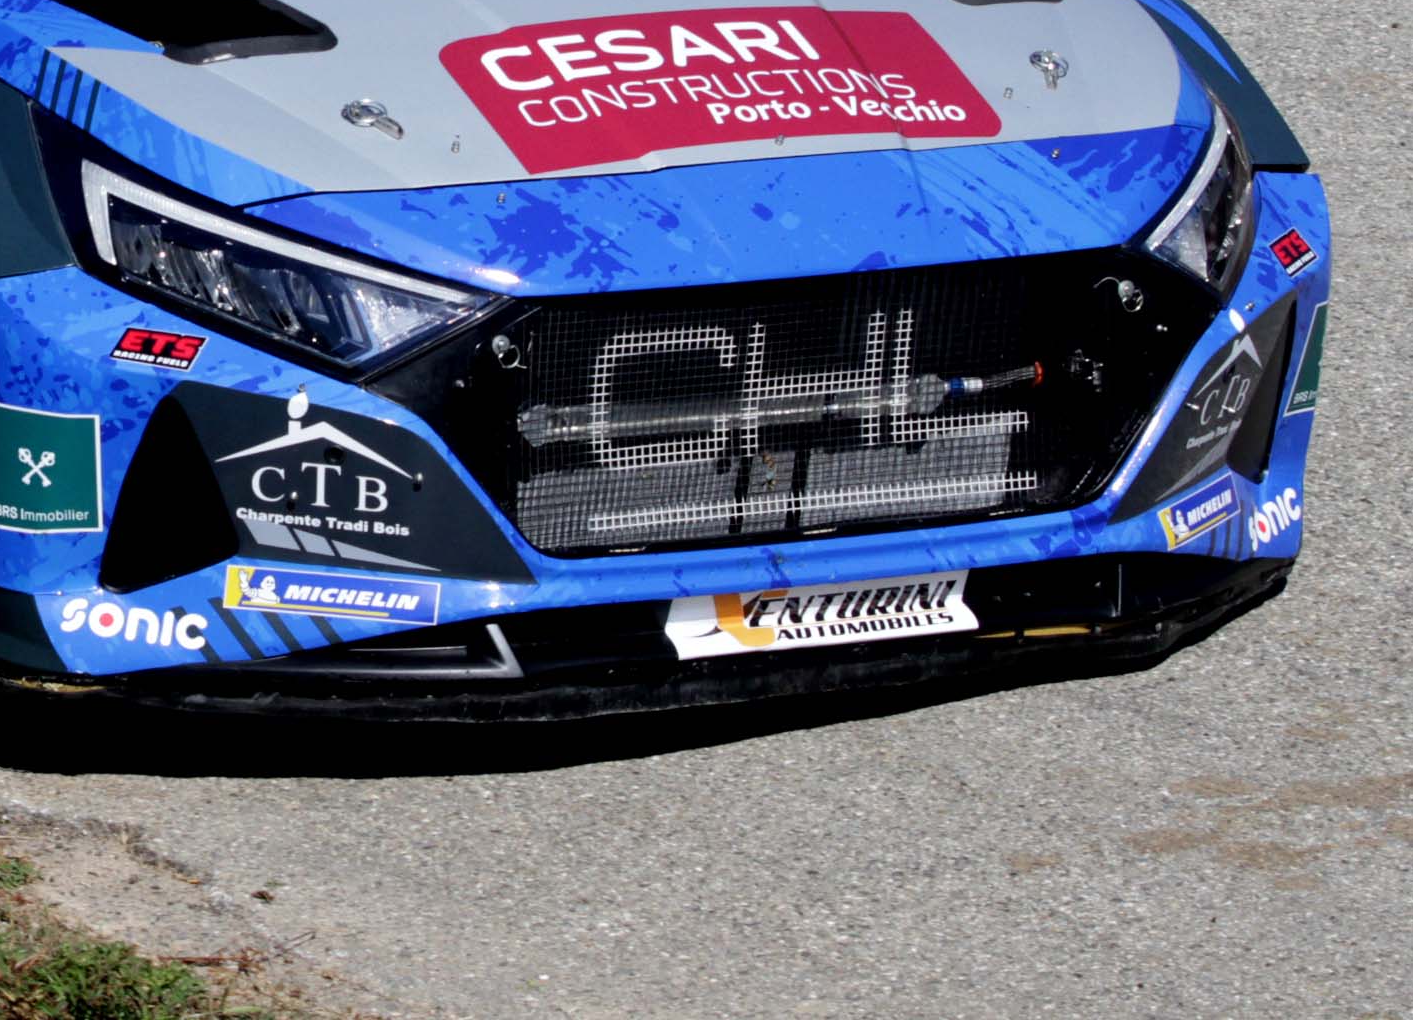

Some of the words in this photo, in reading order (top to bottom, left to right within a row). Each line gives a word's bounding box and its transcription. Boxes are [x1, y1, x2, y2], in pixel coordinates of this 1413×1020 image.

[480, 18, 820, 92] CESARI
[517, 68, 917, 127] CONSTRUCTIONS
[711, 95, 812, 126] Porto
[838, 95, 967, 126] Vecchio
[1273, 231, 1309, 266] ETS
[113, 350, 155, 362] RACING
[156, 356, 189, 368] FUELS
[120, 329, 203, 360] ETS
[589, 308, 1030, 471] CHL
[20, 508, 90, 522] Immobilier
[236, 507, 322, 528] Charpente
[326, 517, 368, 533] Tradi
[373, 522, 410, 536] Bois
[1187, 488, 1233, 526] MICHELIN
[284, 584, 421, 611] MICHELIN
[777, 611, 955, 642] AUTOMOBILES
